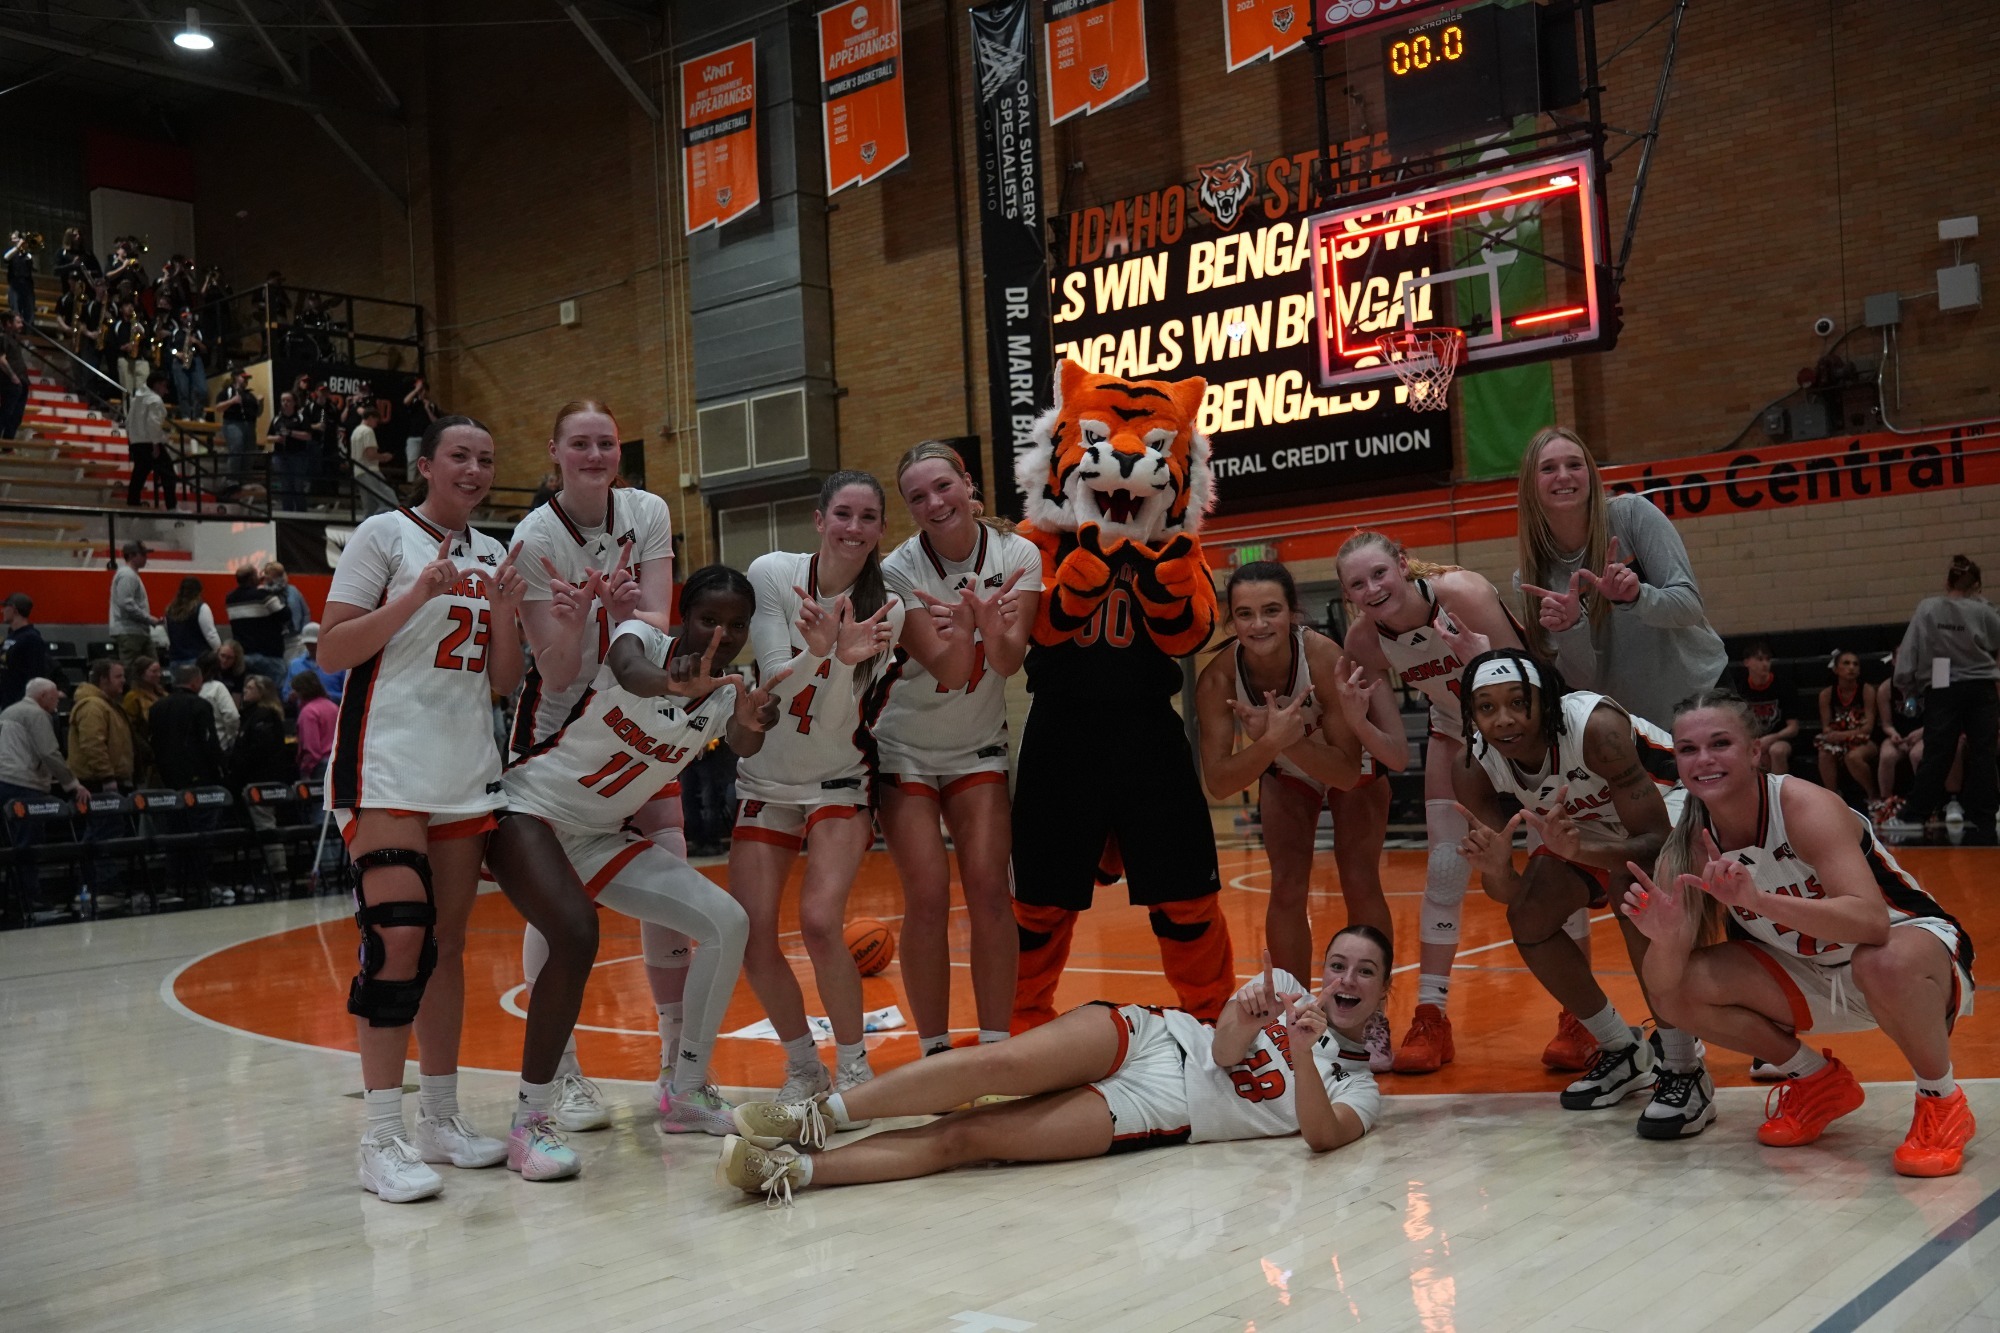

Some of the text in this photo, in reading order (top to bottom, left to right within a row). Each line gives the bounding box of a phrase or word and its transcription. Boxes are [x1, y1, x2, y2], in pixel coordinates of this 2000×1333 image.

[1408, 13, 1463, 35] DAKTRONICS
[702, 61, 734, 83] WNIT
[828, 30, 897, 71] APPEARANCES
[1392, 26, 1463, 76] 00.0
[689, 84, 752, 119] APPEARANCES
[829, 64, 893, 96] WOMEN'S BASKETBALL
[983, 119, 997, 211] OF IDAHO
[1000, 98, 1018, 220] SPECIALISTS
[1017, 79, 1037, 228] ORAL SURGERY
[1067, 184, 1186, 267] IDAHO
[1093, 251, 1169, 315] WIN
[1186, 214, 1370, 294] BENGAS
[1005, 286, 1030, 327] DR.
[1192, 300, 1272, 360] WIN
[329, 376, 362, 394] BENG
[1007, 335, 1035, 407] MARK
[1272, 441, 1349, 470] CREDIT
[1355, 428, 1431, 458] UNION
[1725, 428, 1965, 508] Central
[434, 605, 491, 673] 23
[1400, 655, 1464, 682] BENGA
[603, 706, 689, 763] BENGALS
[788, 684, 817, 735] 4
[578, 750, 649, 799] 11
